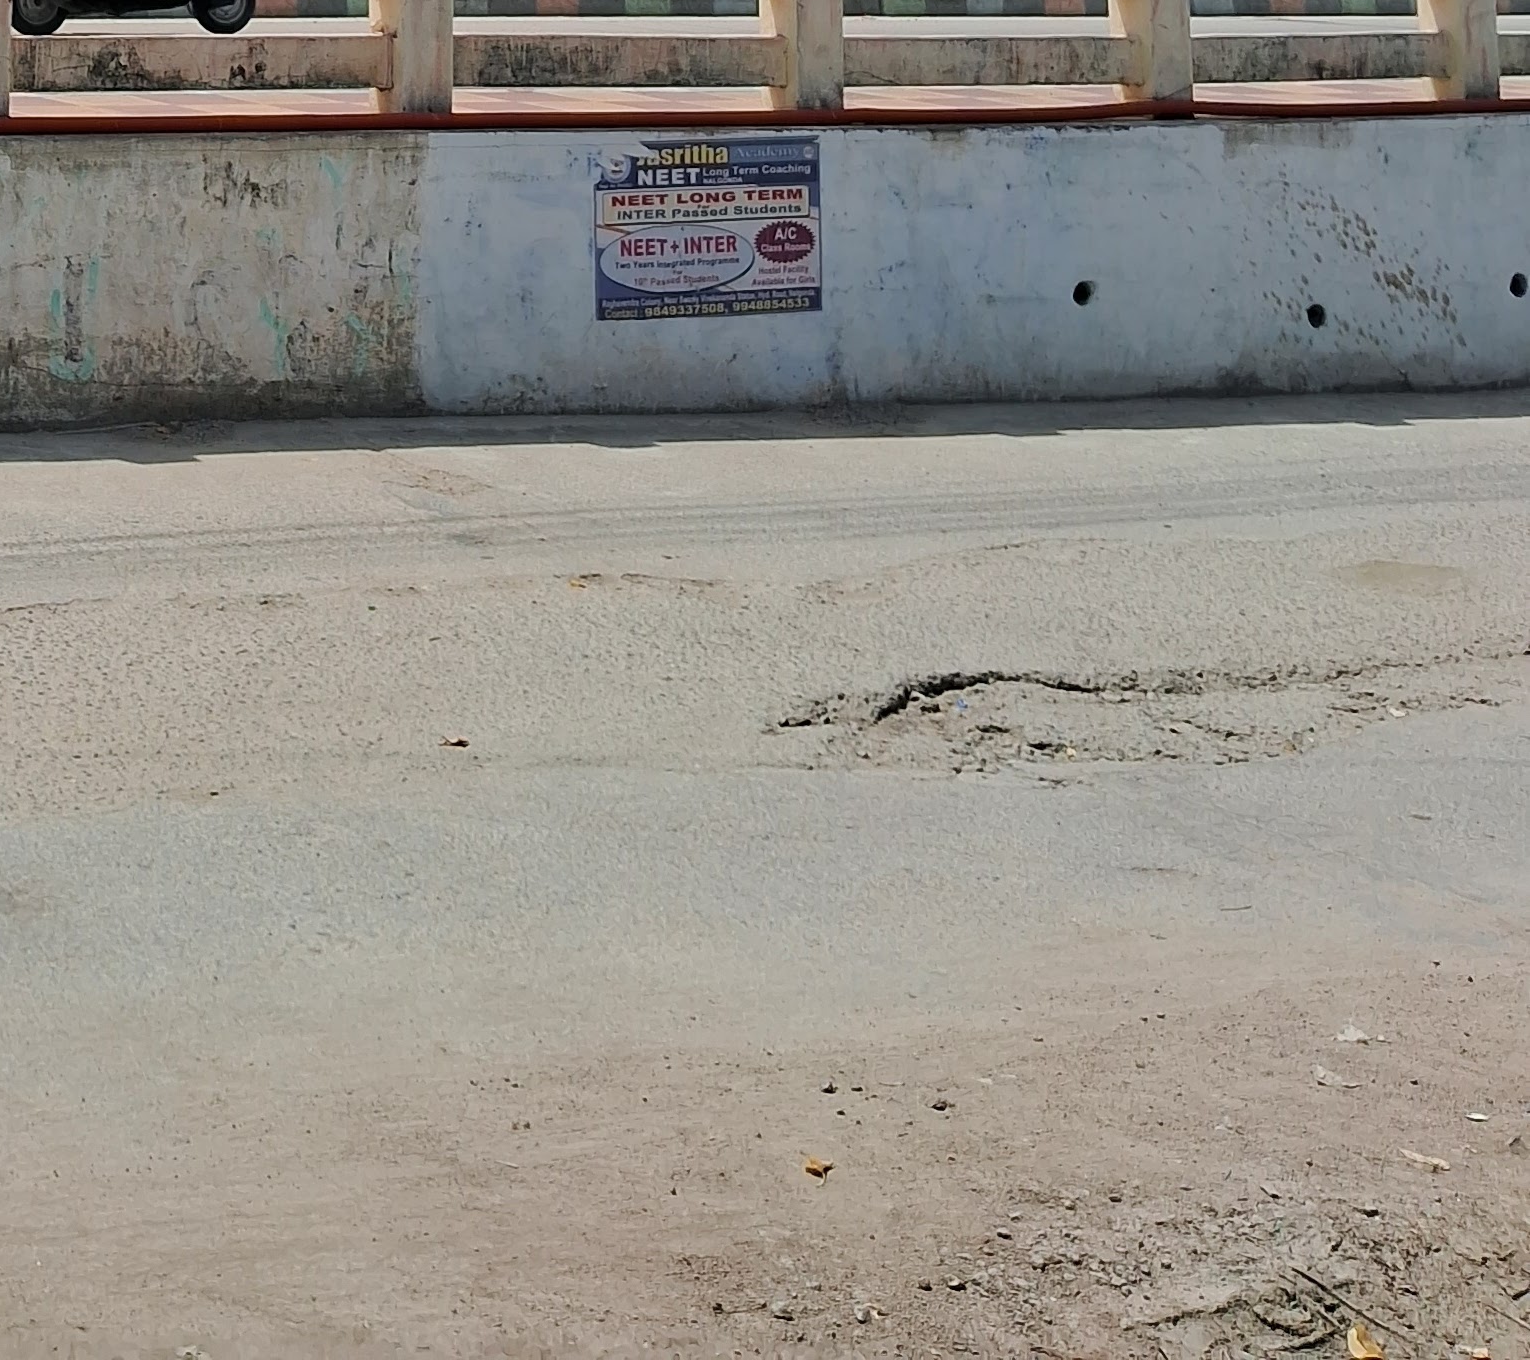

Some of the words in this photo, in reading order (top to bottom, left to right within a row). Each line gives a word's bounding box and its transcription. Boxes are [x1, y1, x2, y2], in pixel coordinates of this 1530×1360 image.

[734, 146, 800, 159] Academy
[638, 167, 700, 186] NEET
[703, 167, 729, 177] Long
[732, 166, 759, 175] Term
[761, 164, 811, 175] Coaching
[611, 194, 669, 207] NEET
[676, 191, 736, 204] LONG
[743, 188, 803, 201] TERM
[617, 209, 667, 220] INTER
[671, 206, 728, 219] Passed
[733, 204, 802, 216] Students
[775, 226, 797, 240] A/C
[620, 238, 668, 257] NEET
[670, 241, 679, 254] +
[684, 235, 738, 254] INTER
[615, 261, 631, 269] Two
[633, 260, 654, 268] Years
[656, 258, 695, 269] Integrated
[697, 257, 740, 267] Programme
[650, 276, 681, 286] Passed
[683, 275, 719, 284] Students
[752, 277, 785, 286] Available
